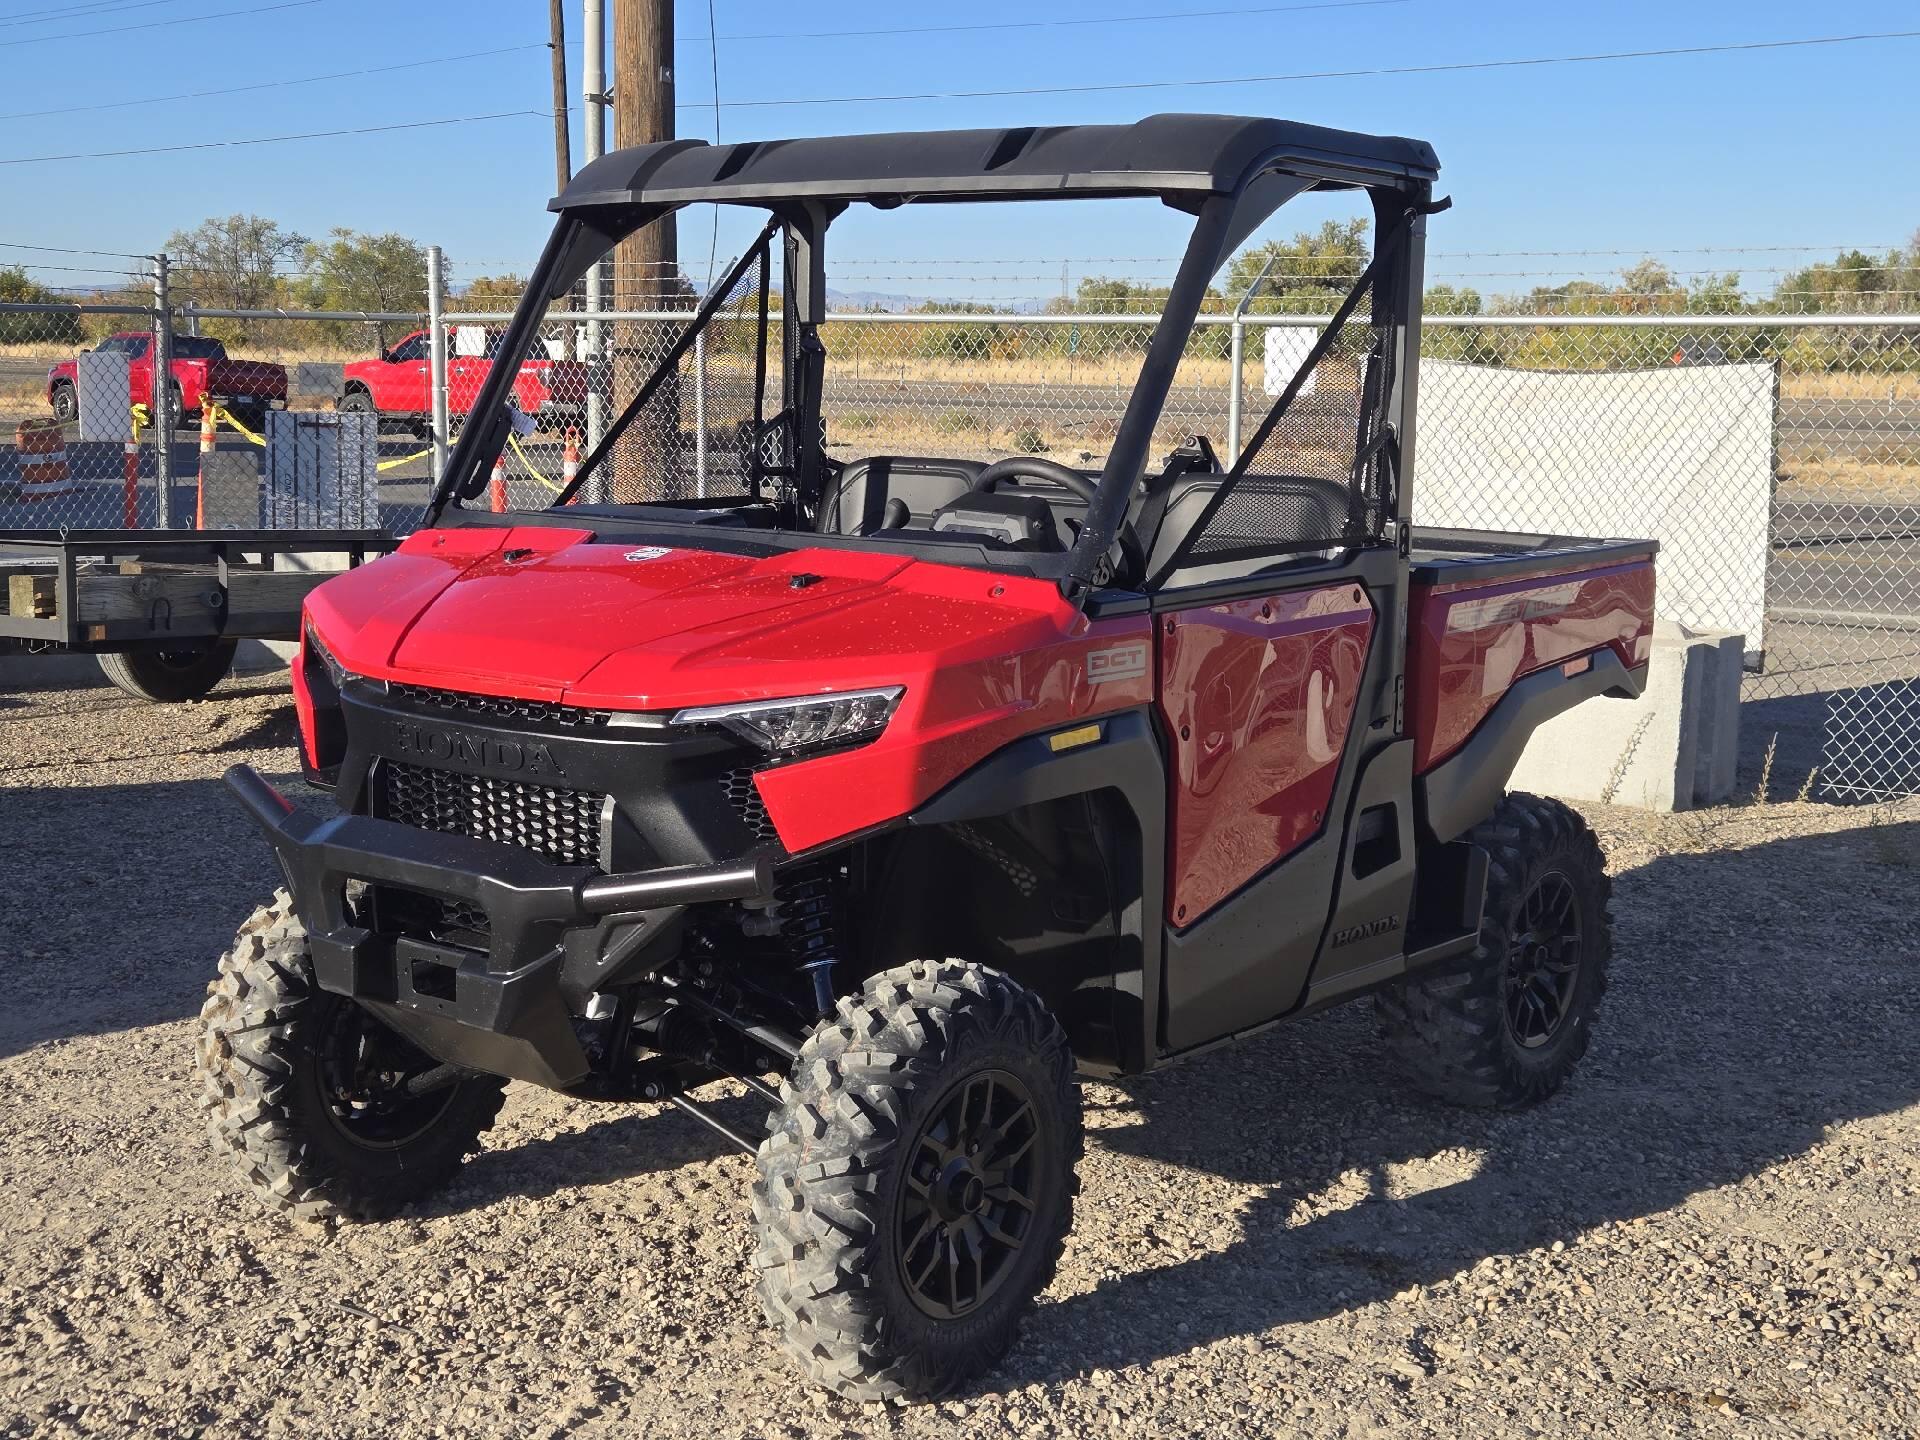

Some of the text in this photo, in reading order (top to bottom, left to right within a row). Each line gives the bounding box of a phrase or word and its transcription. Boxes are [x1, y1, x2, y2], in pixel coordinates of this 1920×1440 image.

[1091, 649, 1142, 671] DCT
[396, 720, 566, 776] HONDA
[1332, 914, 1401, 947] HONDA
